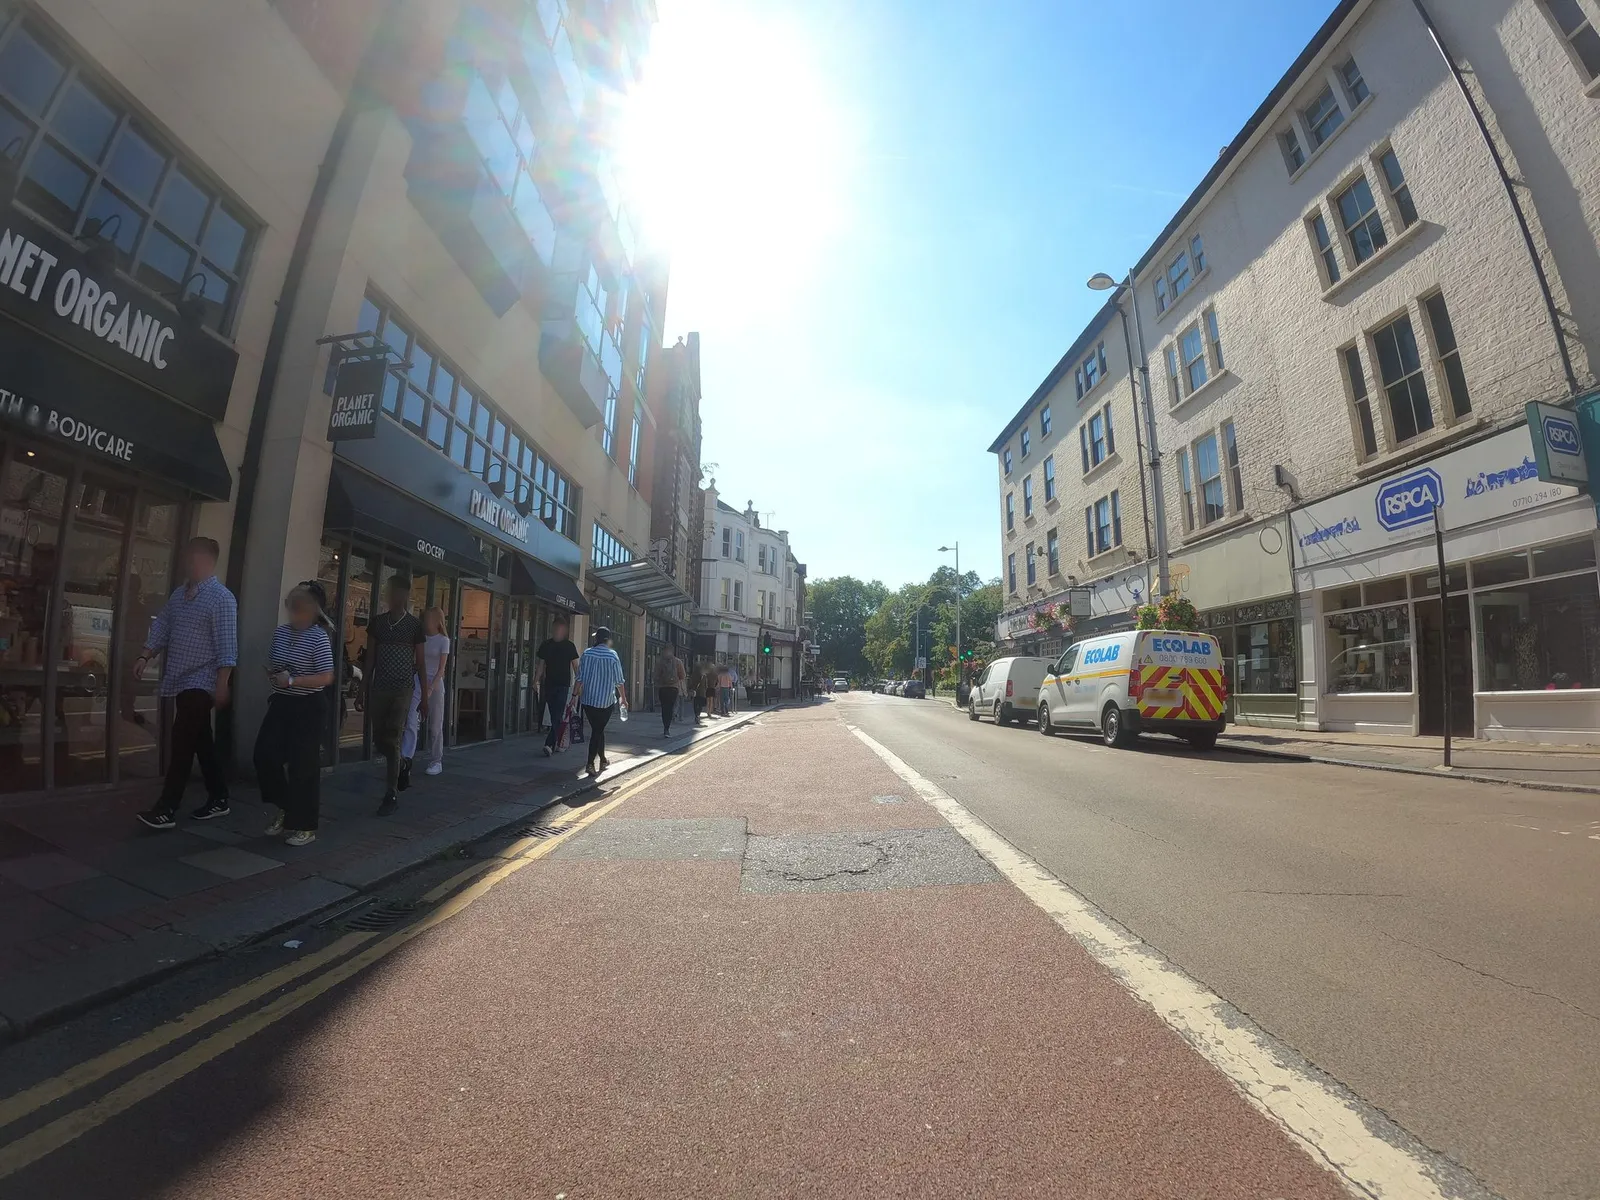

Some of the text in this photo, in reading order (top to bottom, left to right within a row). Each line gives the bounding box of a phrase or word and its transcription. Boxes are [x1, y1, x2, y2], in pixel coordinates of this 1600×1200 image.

[0, 228, 175, 369] NET ORGANIC
[336, 393, 375, 411] PLANET
[331, 408, 375, 428] ORGANIC
[47, 410, 134, 461] BODYCARE
[1548, 426, 1577, 445] RSPCA
[1384, 484, 1435, 517] RSPCA
[1512, 487, 1562, 508] 07710 294 180
[470, 489, 530, 543] PLANET ORGANIC
[417, 539, 446, 560] GROCERY
[1084, 644, 1121, 665] ECOLAB
[1152, 638, 1211, 655] ECOLAB
